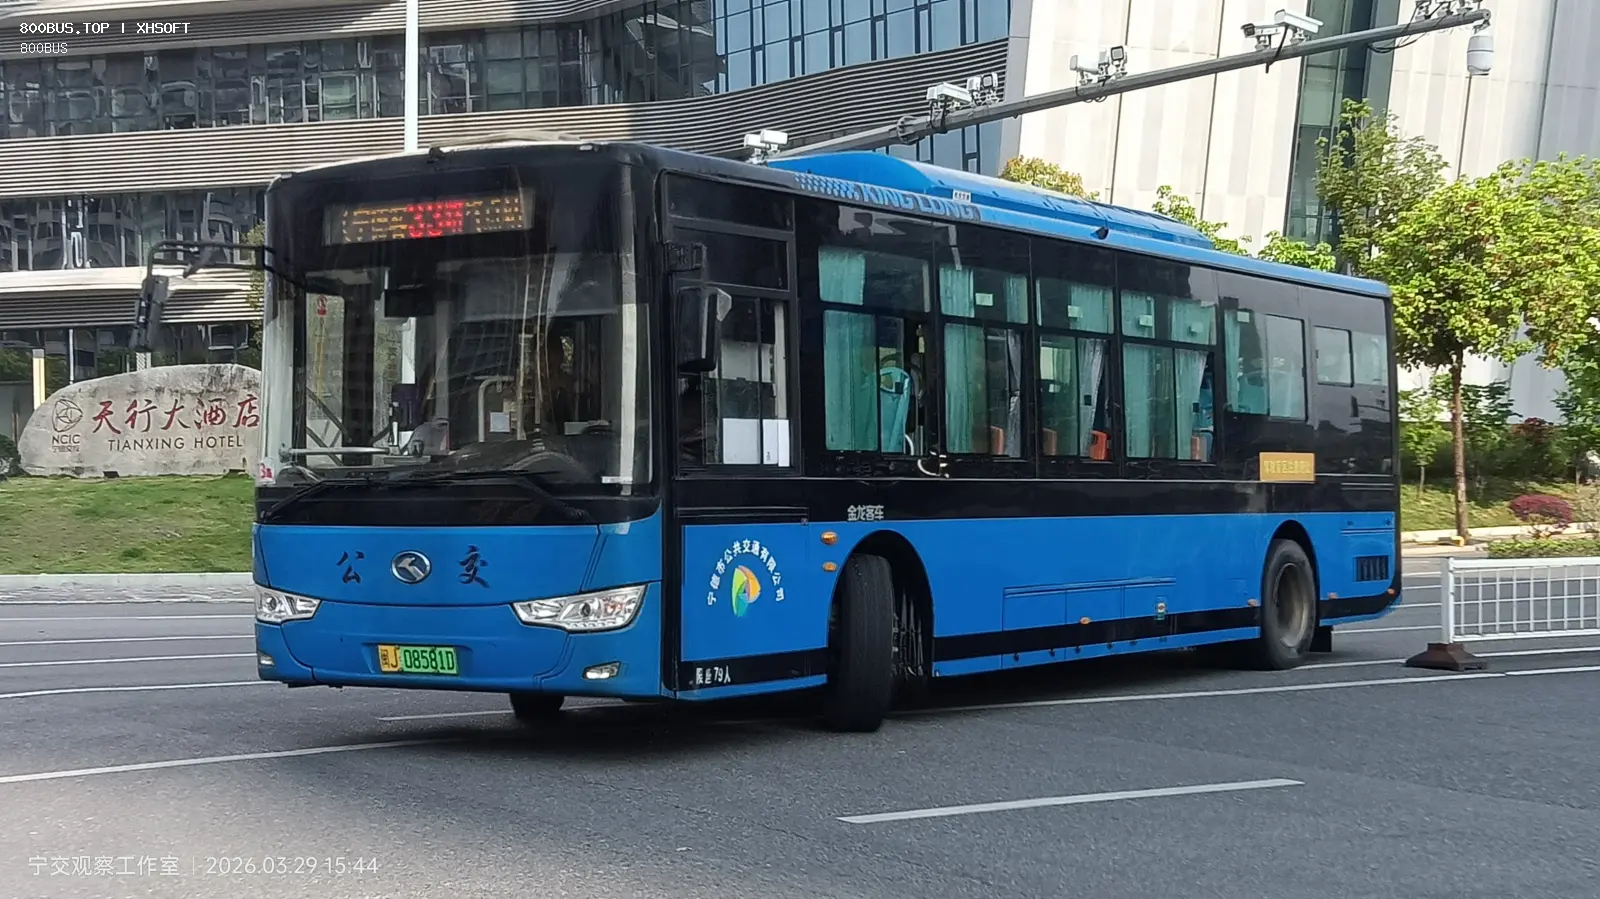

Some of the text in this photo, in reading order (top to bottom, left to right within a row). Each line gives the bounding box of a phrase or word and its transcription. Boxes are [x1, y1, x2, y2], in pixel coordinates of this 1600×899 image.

[862, 184, 977, 221] KING LONG
[92, 393, 260, 435] 天行大酒店
[51, 434, 81, 445] NCIC
[108, 435, 243, 451] TIANXING HOTEL
[847, 504, 885, 521] 金龙客车
[336, 544, 490, 588] 公 交
[707, 538, 785, 606] 宁德市公共交通有限公司
